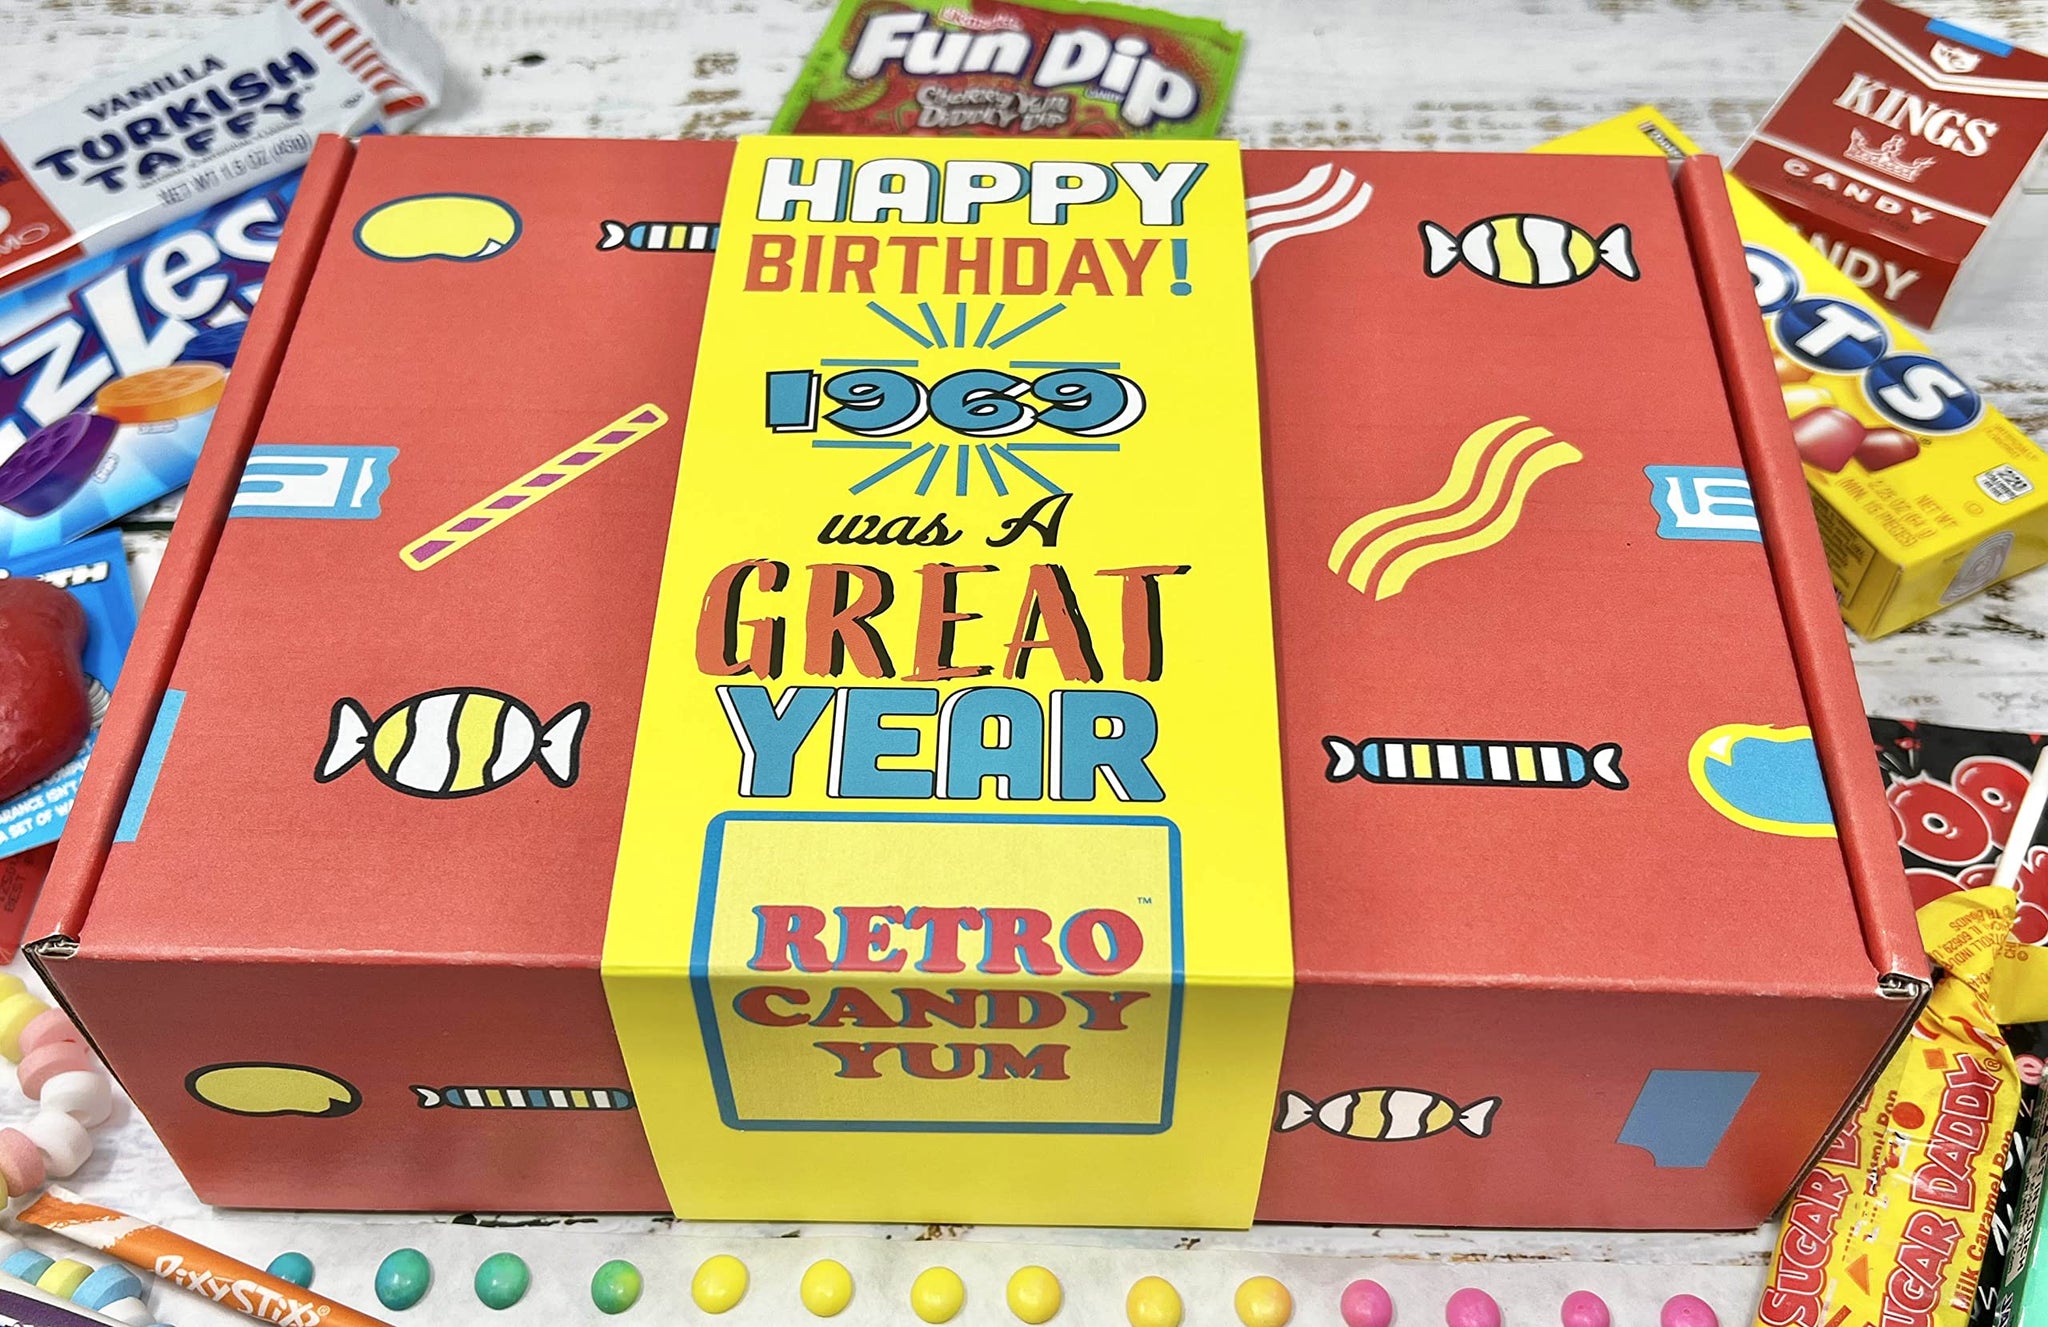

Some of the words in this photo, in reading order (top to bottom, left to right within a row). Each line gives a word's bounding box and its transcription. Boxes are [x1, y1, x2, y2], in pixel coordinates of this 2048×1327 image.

[85, 54, 226, 121] VANILLA
[847, 12, 1034, 80] Fun
[1034, 28, 1199, 128] Dip
[35, 49, 319, 178] TURKISH
[82, 90, 306, 194] TAFFY
[1833, 70, 2000, 158] KINGS
[756, 157, 1209, 226] HAPPY
[1783, 157, 1935, 225] CANDY
[743, 234, 1193, 296] BIRTHDAY!
[765, 368, 1147, 438] 1969
[816, 511, 963, 547] was
[985, 492, 1074, 548] A
[695, 557, 1192, 684] GREAT
[715, 684, 1167, 803] YEAR
[747, 905, 1145, 976] RETRO
[732, 985, 1152, 1031] CANDY
[813, 1040, 1072, 1081] YUM
[1909, 1052, 2004, 1213] DADDY
[2030, 1183, 2040, 1204] IN
[1758, 1166, 1853, 1327] SUGAR
[1950, 1263, 1980, 1314] Milk
[1965, 1173, 2003, 1263] Caramel
[2016, 1204, 2038, 1272] TOUCH
